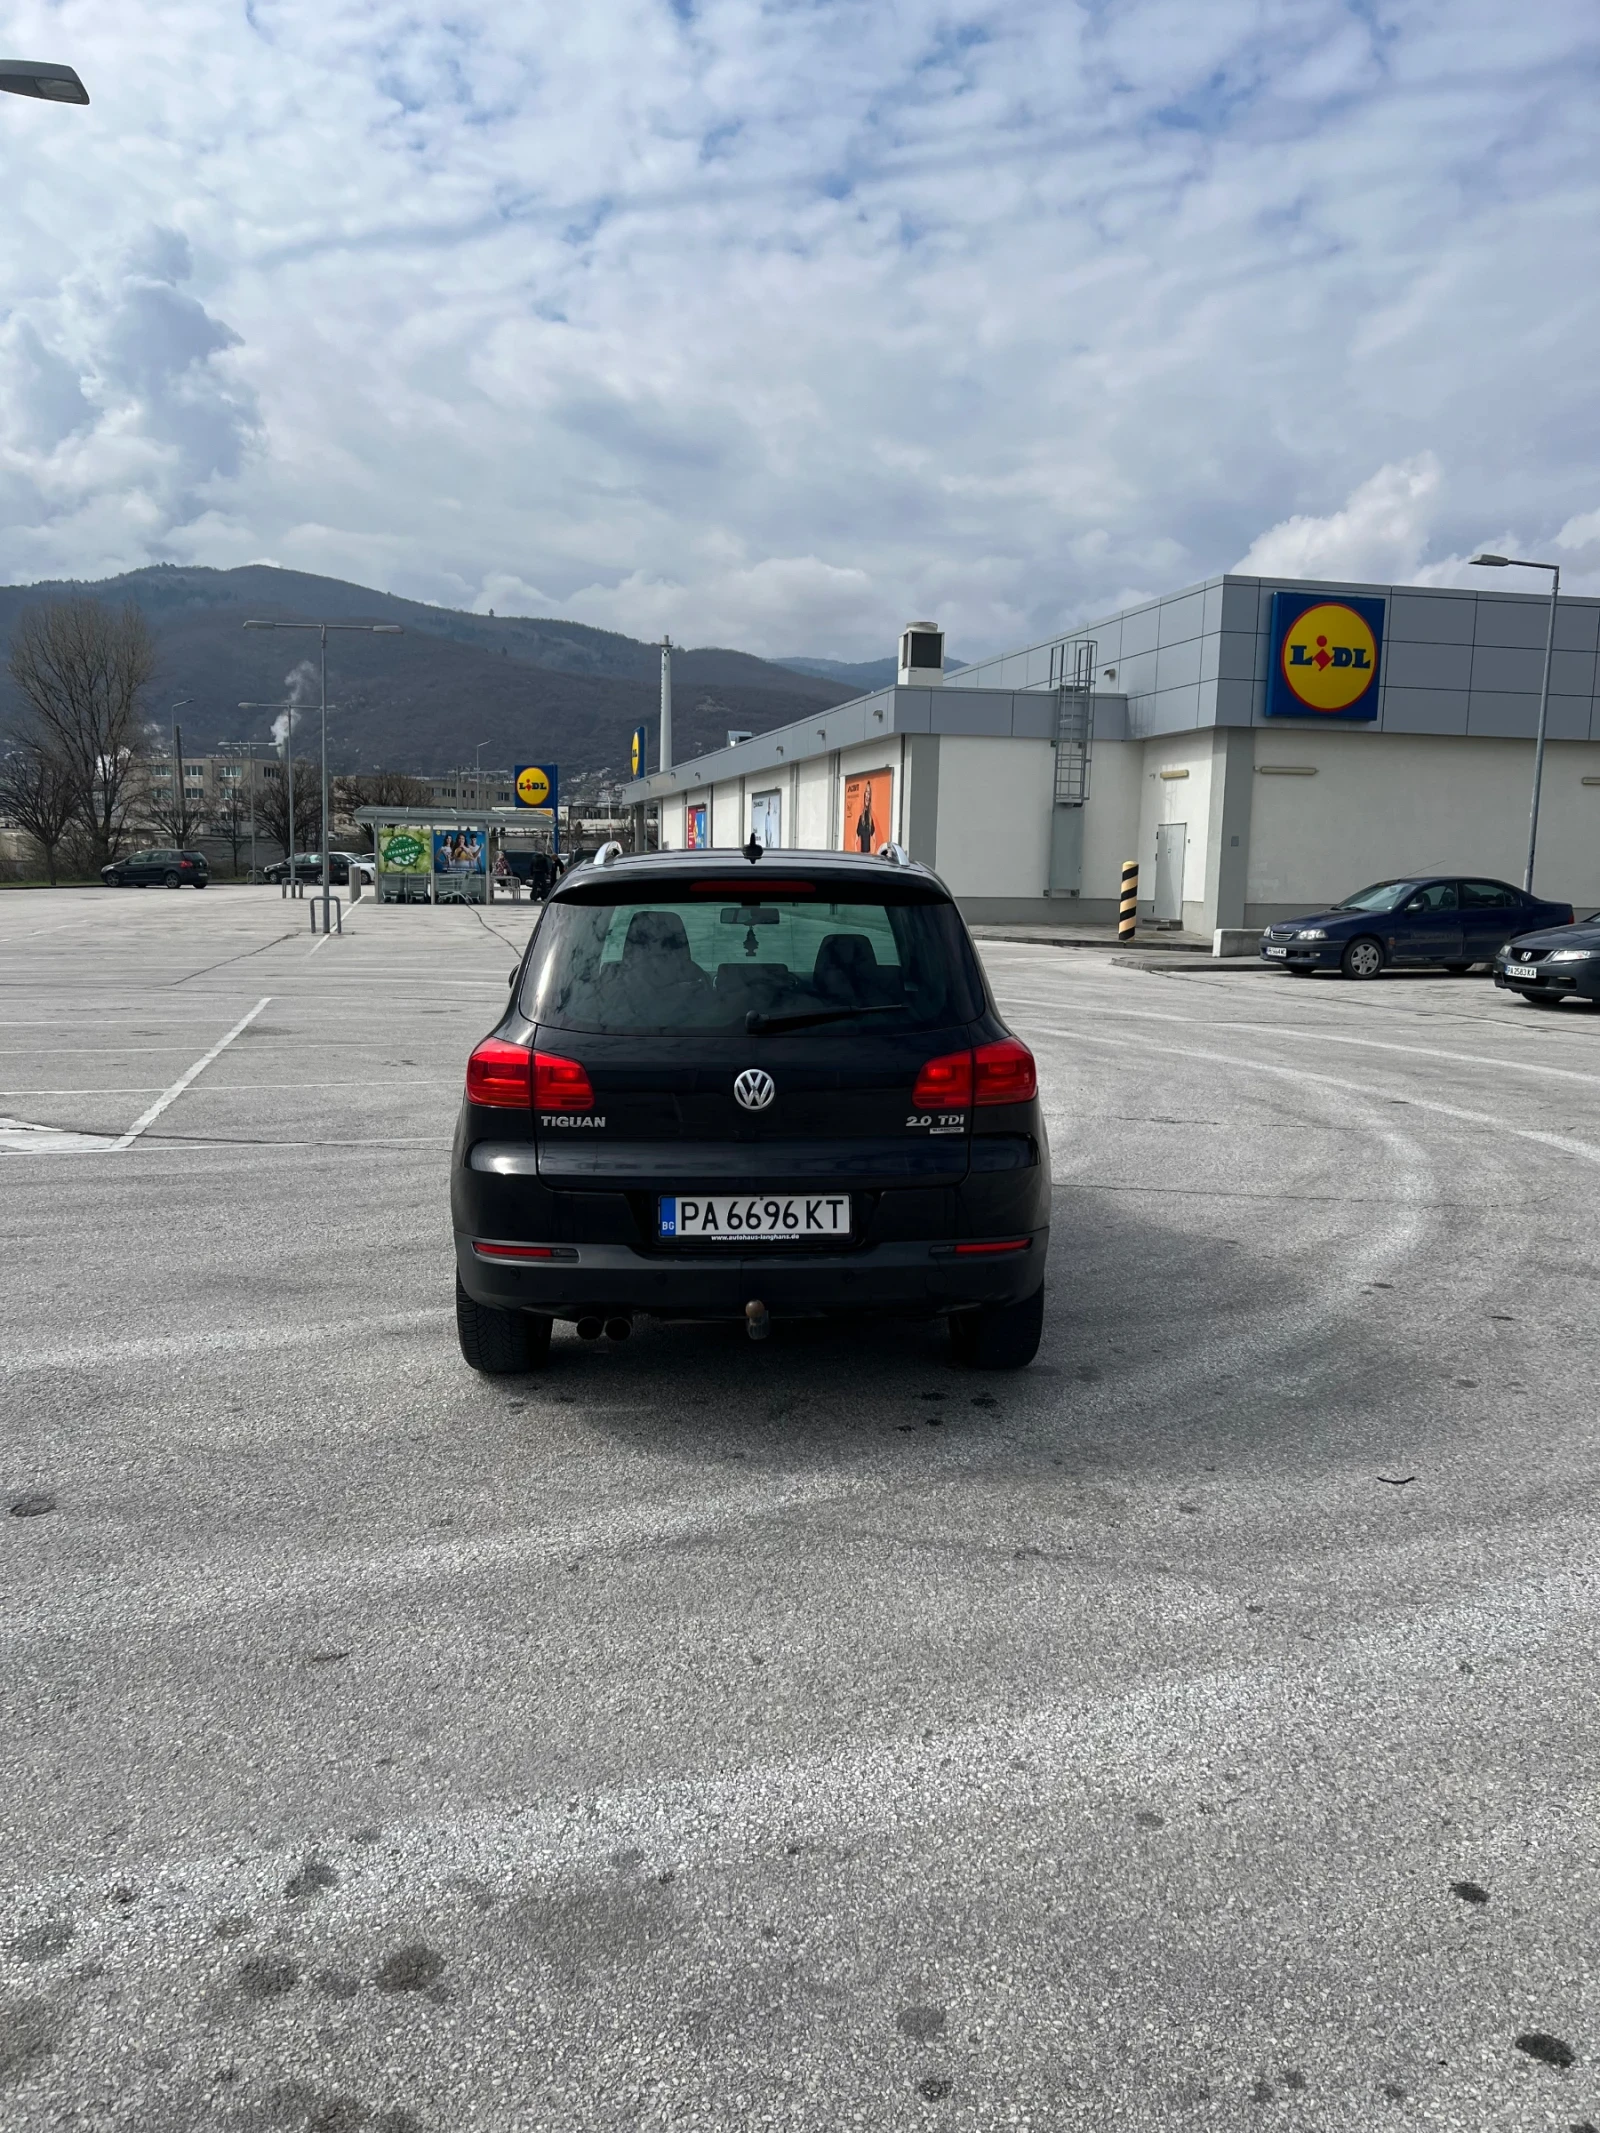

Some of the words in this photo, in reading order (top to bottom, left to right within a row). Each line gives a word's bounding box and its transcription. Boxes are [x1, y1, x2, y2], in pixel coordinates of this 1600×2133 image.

[1289, 635, 1371, 672] LIDL
[518, 778, 547, 791] LIDL
[540, 1115, 606, 1128] TIGUAN
[661, 1221, 675, 1231] BG
